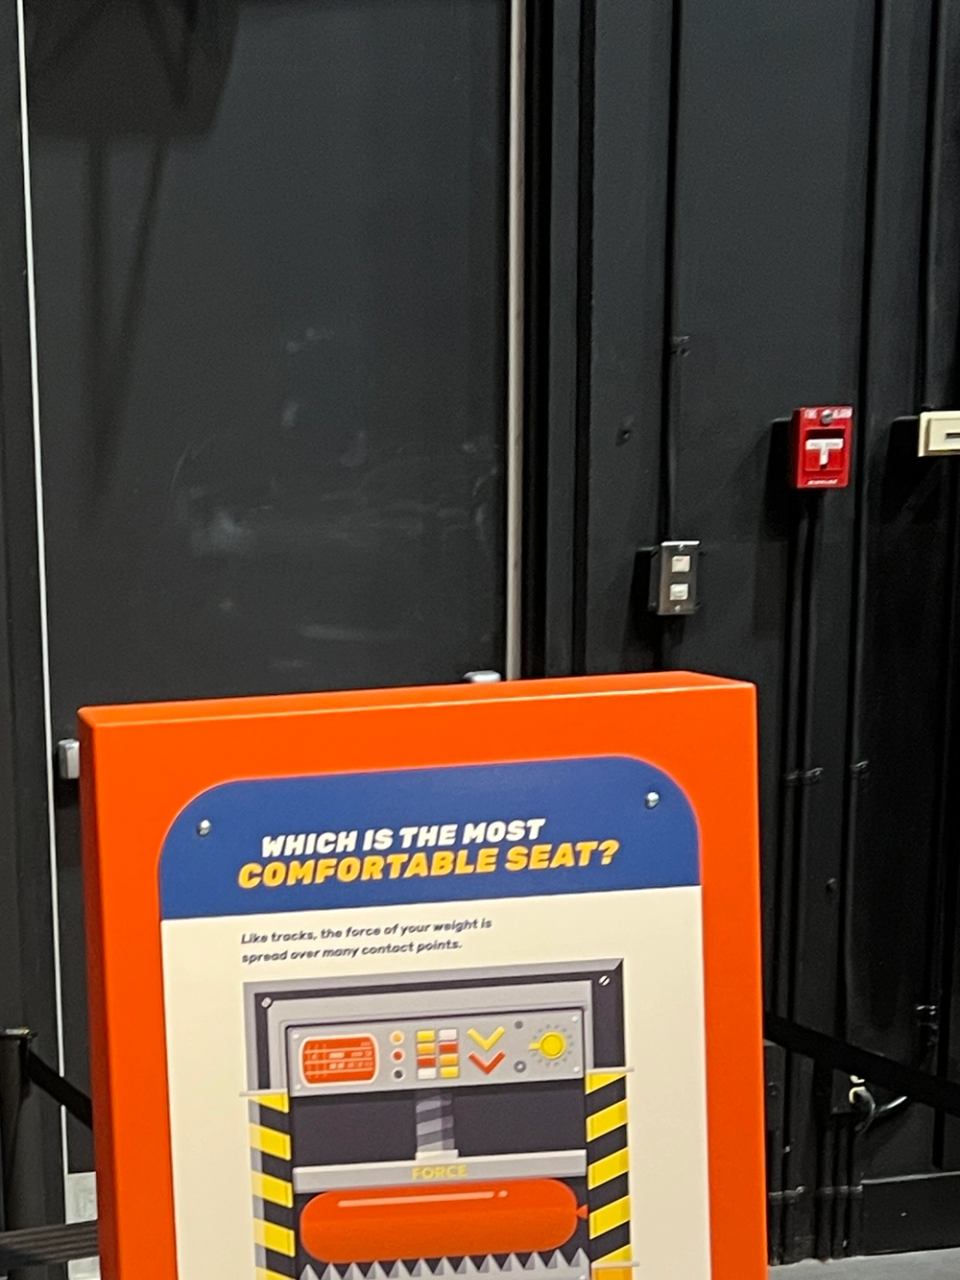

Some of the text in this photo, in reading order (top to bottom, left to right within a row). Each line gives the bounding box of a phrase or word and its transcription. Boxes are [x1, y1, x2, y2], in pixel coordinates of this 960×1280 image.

[261, 818, 546, 858] WHICH IS THE MOST
[238, 839, 620, 889] COMFORTABLE SEAT?
[241, 918, 492, 945] Like tracks, the force of your weight is
[242, 938, 462, 965] spread over many contact points.
[412, 1164, 467, 1181] FORCE
